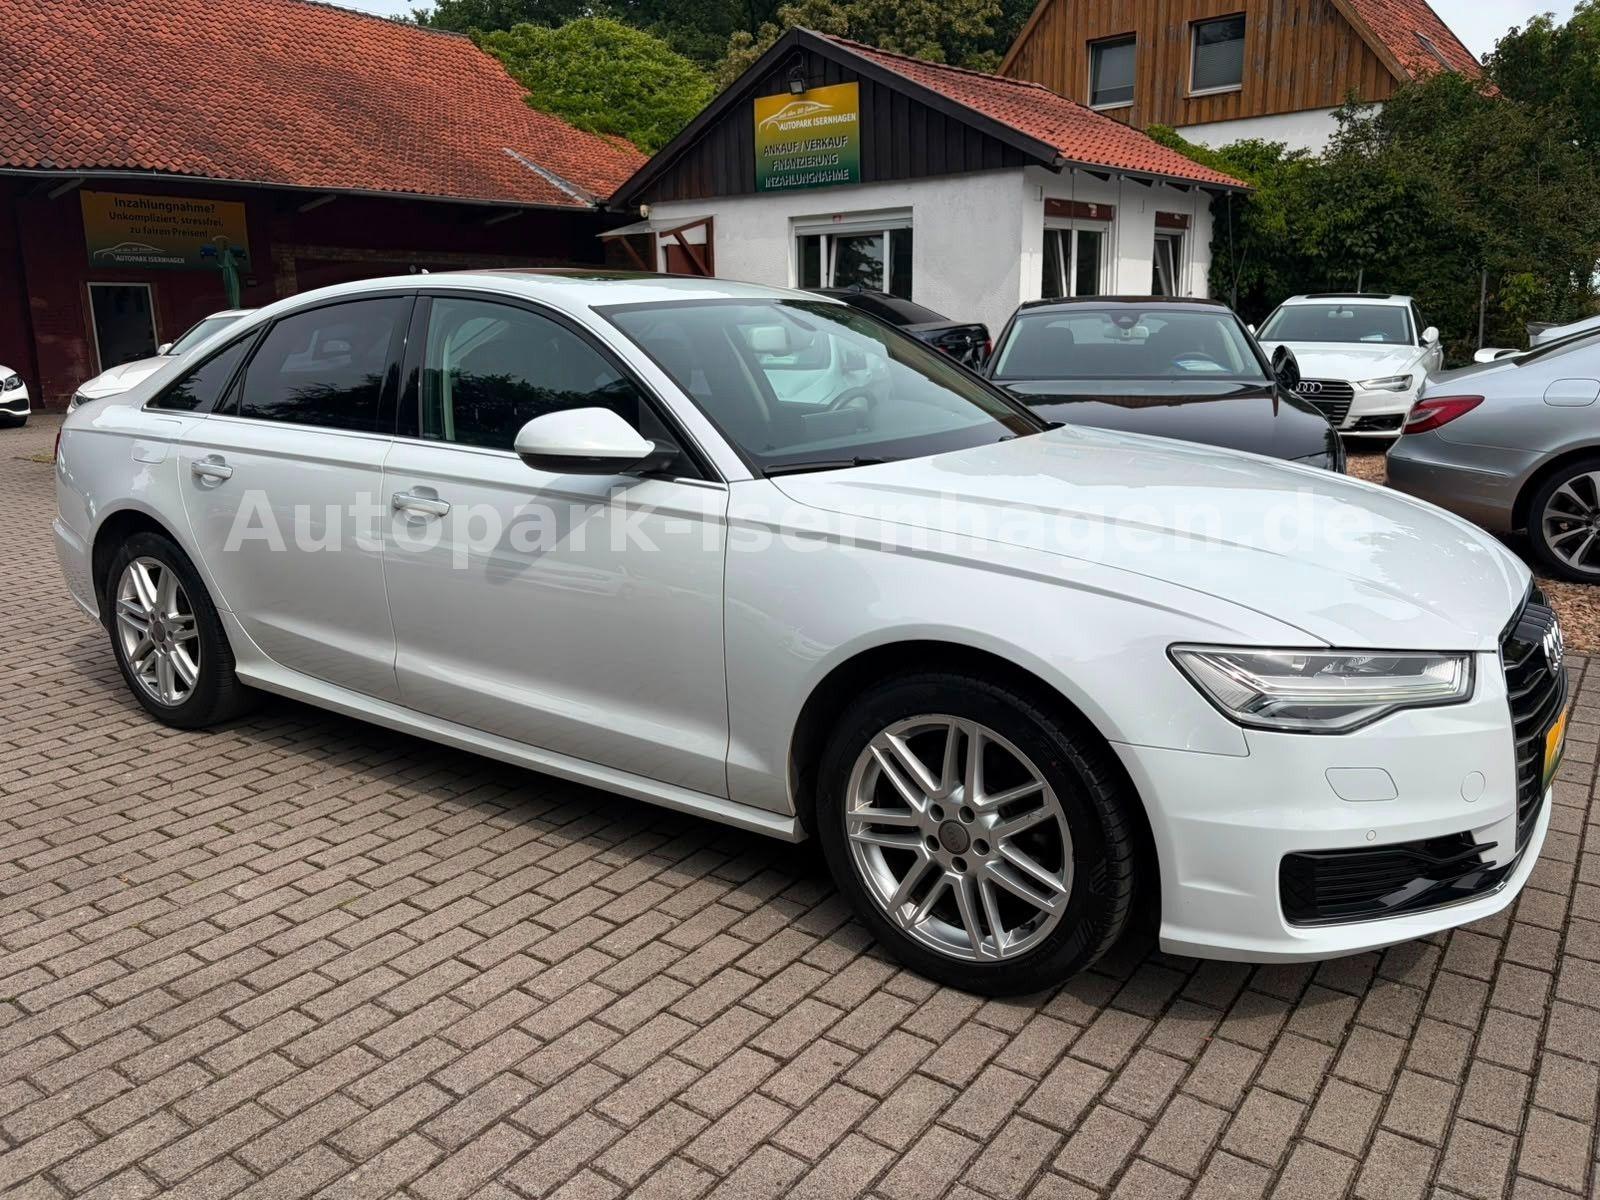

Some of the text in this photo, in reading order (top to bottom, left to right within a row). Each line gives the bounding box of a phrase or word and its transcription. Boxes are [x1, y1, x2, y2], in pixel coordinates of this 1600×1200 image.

[779, 119, 812, 131] AUTOPARK
[813, 112, 857, 126] ISERNHAGEN
[773, 154, 839, 171] FINANZIERUNG
[765, 169, 849, 188] INZAHLUNGNAHME
[114, 197, 215, 214] Inzahlungnahme?
[109, 211, 224, 227] Unkompliziert, stressfrei,
[143, 225, 171, 236] fairen
[172, 227, 208, 239] Preisen!
[115, 254, 185, 265] AUTOPARK ISERNHAGEN
